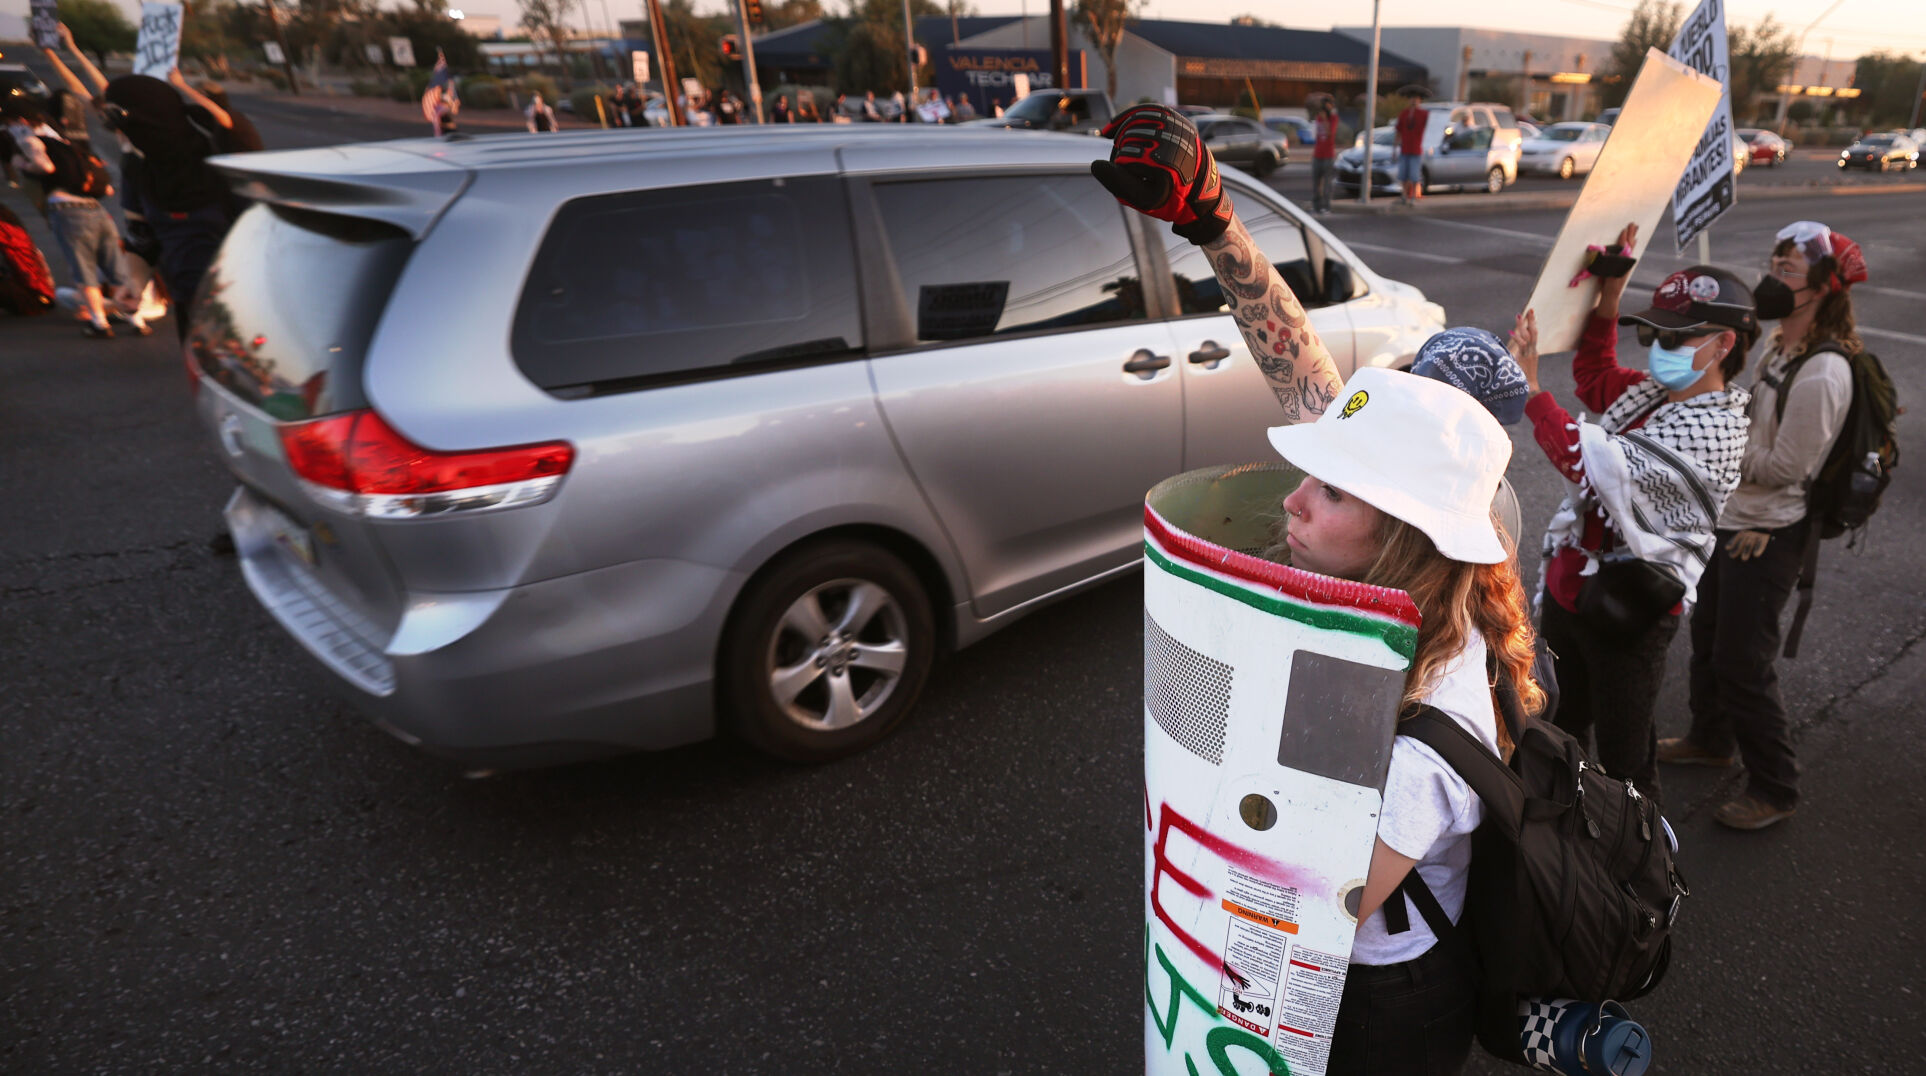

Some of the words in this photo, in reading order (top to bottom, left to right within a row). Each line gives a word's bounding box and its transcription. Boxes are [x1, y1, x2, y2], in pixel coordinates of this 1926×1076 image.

[948, 55, 1039, 72] VALENCIA
[965, 70, 1053, 88] TECHAR
[1238, 907, 1268, 923] WARNING
